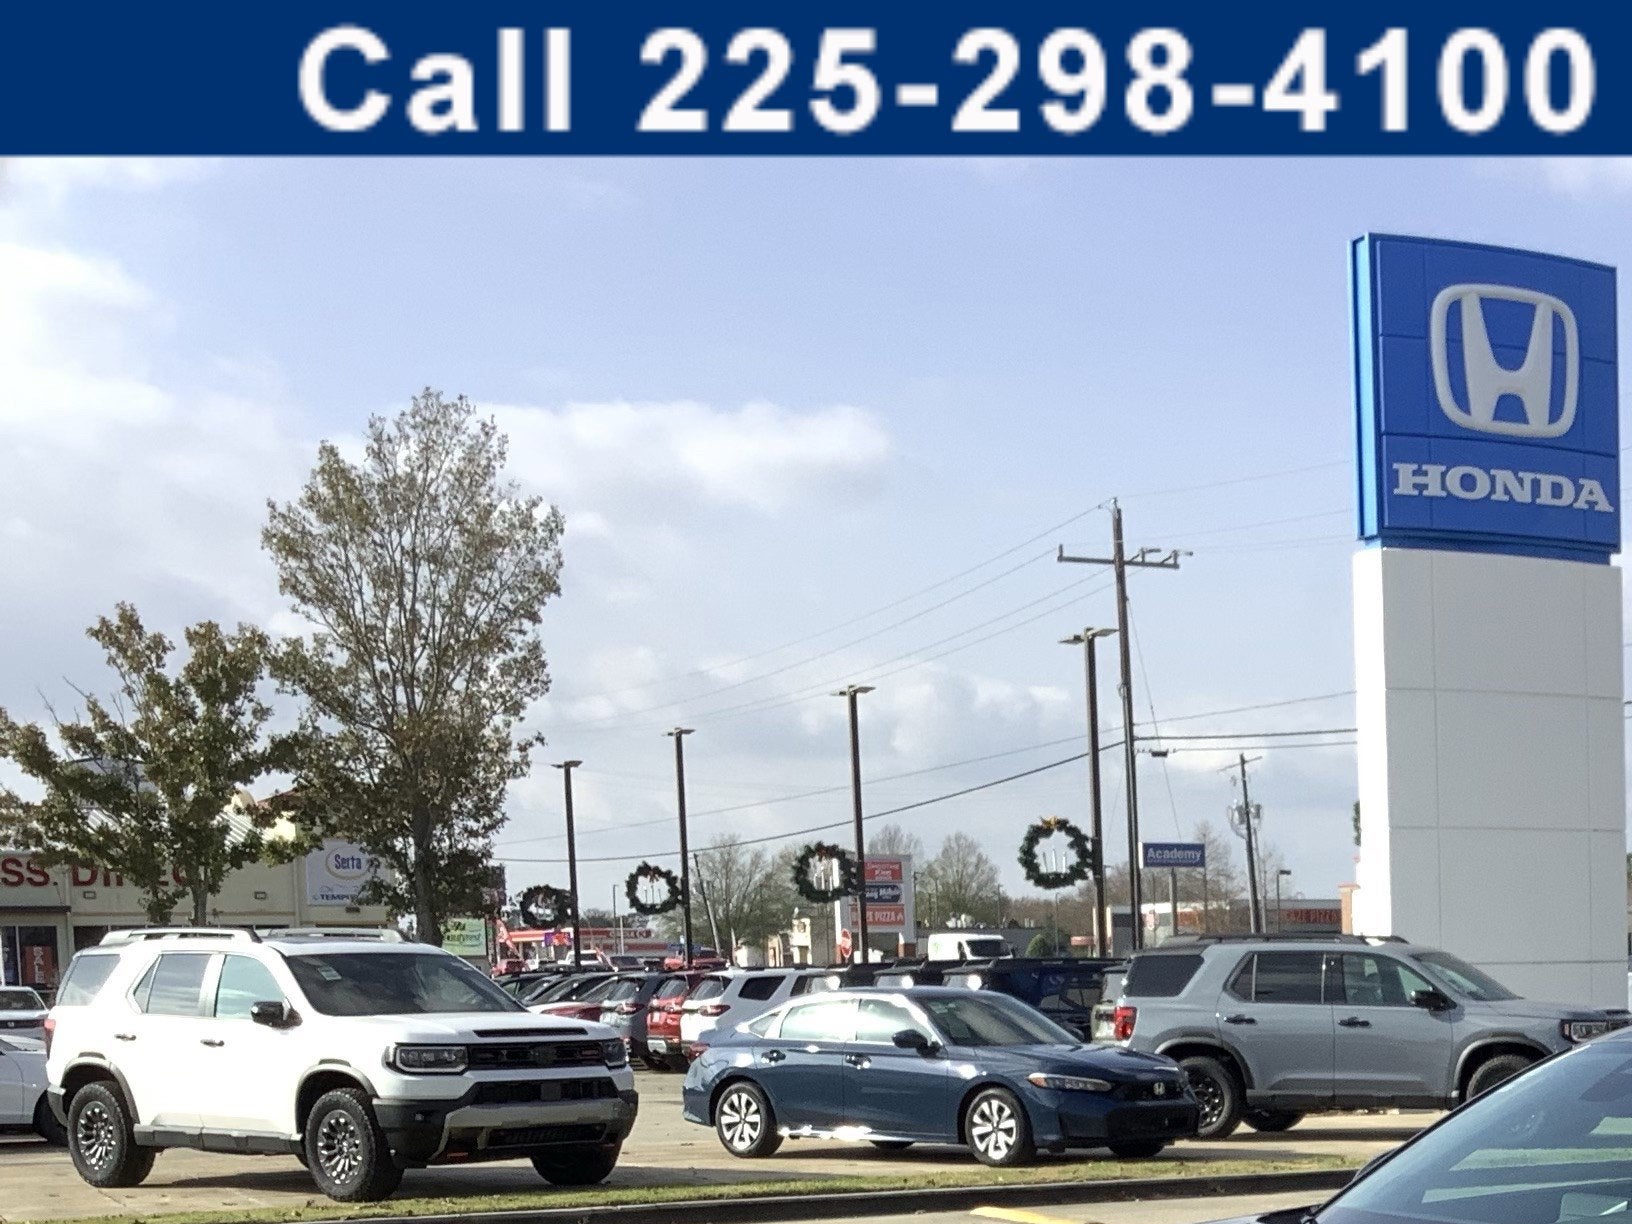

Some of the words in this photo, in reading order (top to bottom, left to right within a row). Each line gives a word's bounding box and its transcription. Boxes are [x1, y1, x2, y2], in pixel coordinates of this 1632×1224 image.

[1393, 462, 1614, 513] HONDA
[334, 853, 362, 869] Serta
[1147, 847, 1202, 863] Academy
[875, 911, 897, 922] PIZZA
